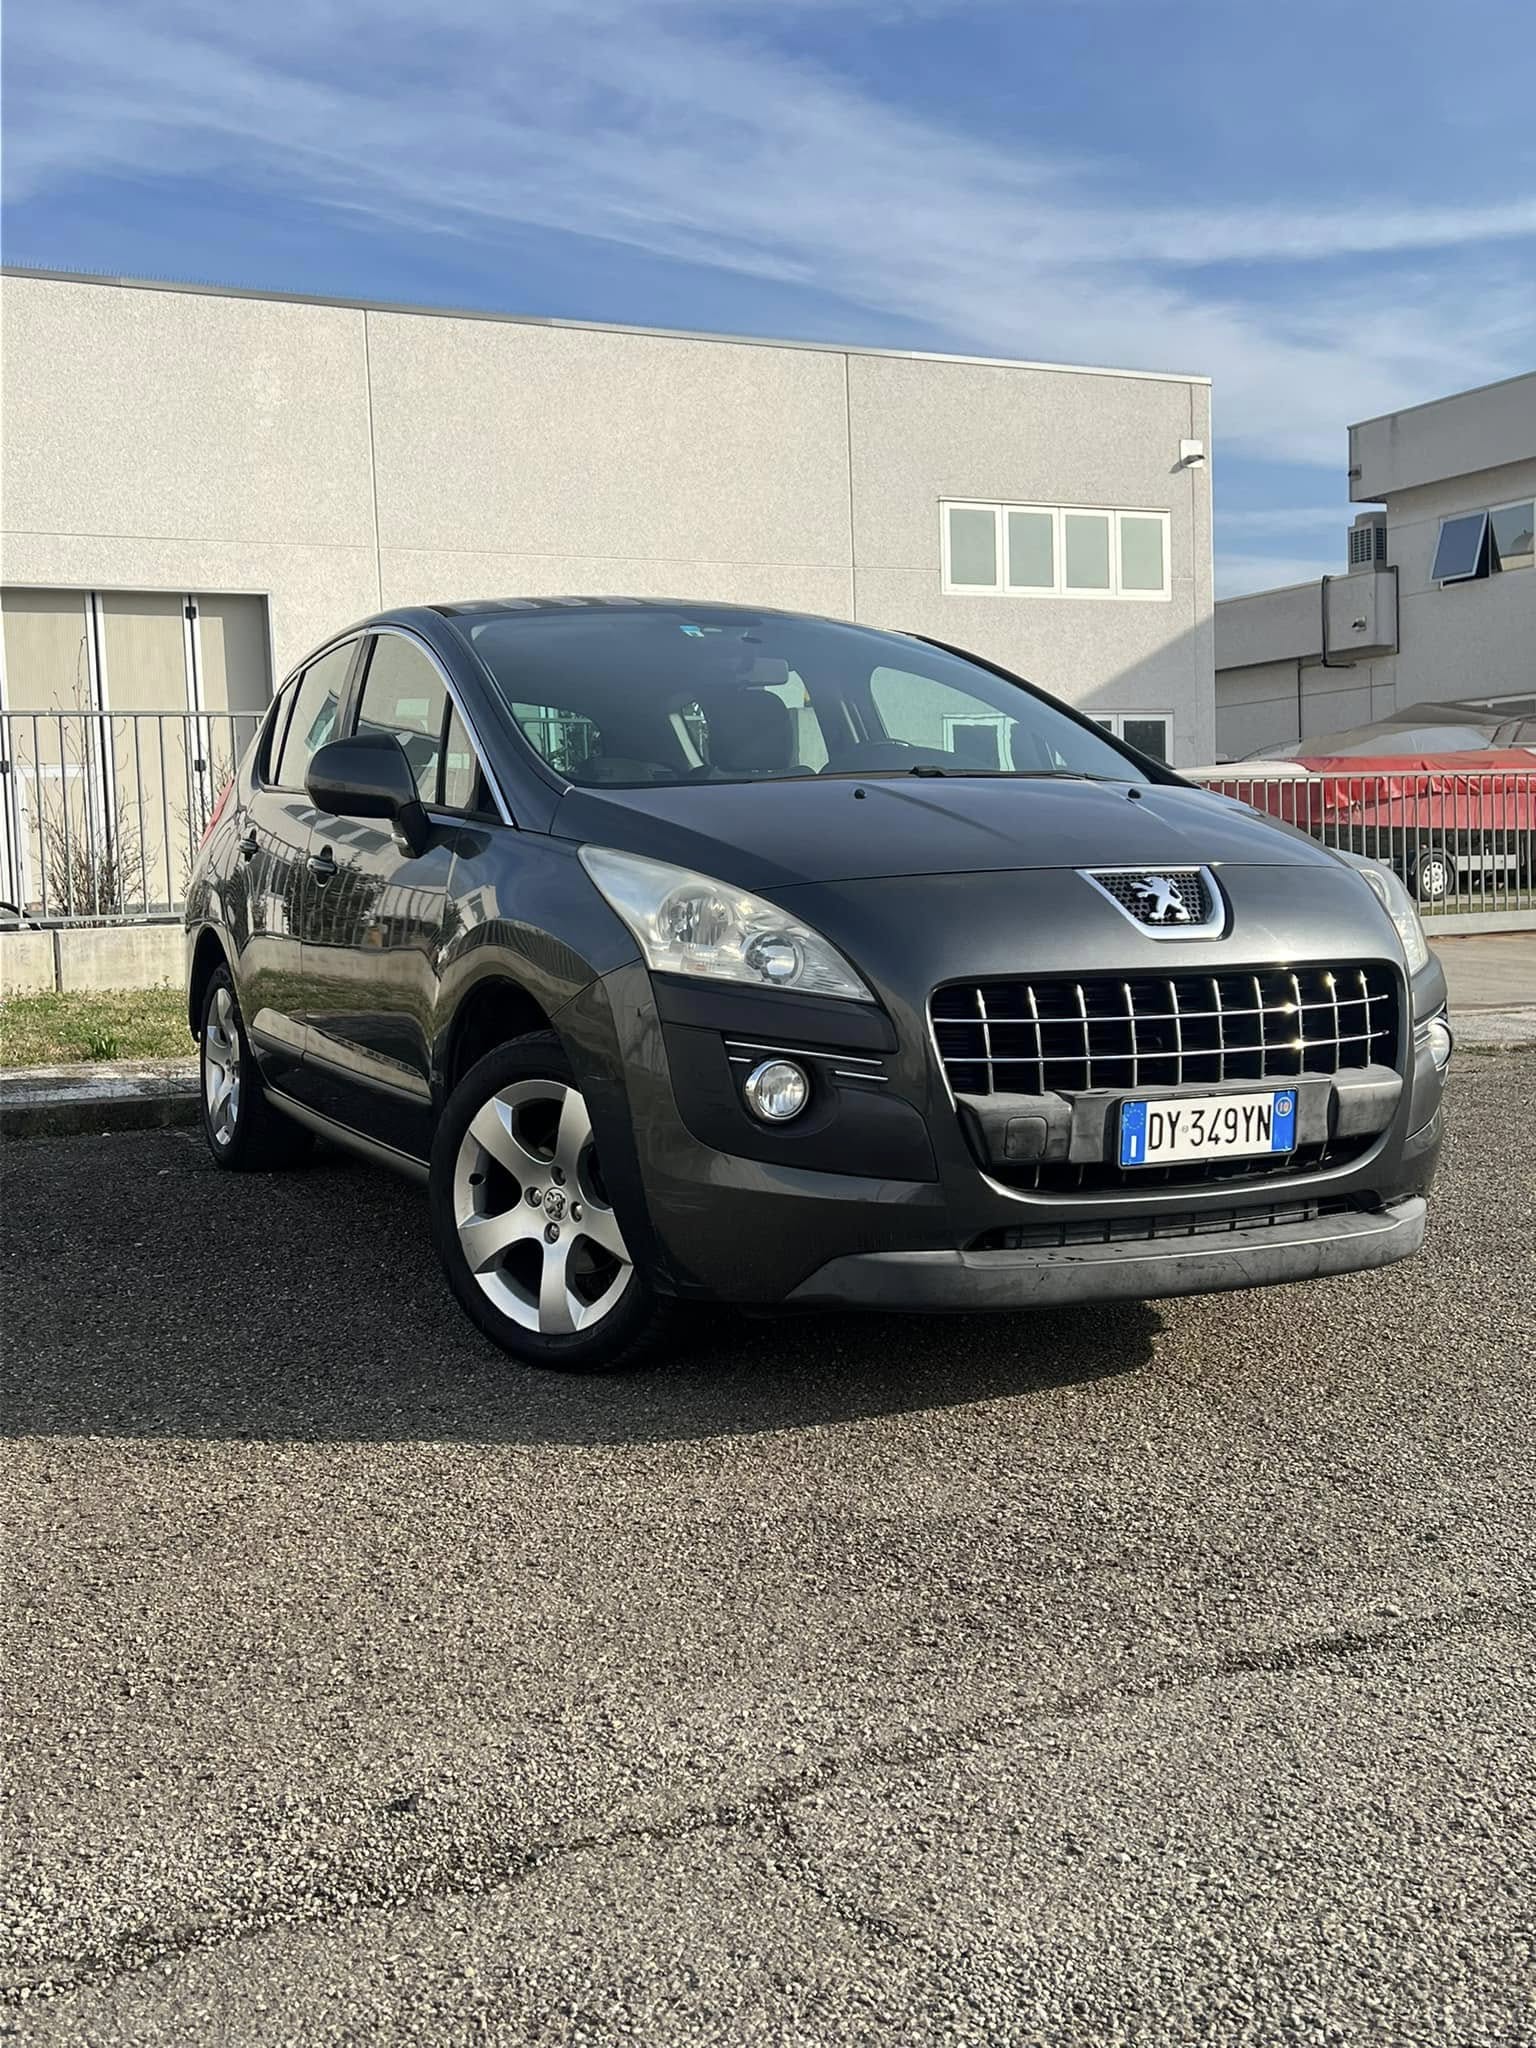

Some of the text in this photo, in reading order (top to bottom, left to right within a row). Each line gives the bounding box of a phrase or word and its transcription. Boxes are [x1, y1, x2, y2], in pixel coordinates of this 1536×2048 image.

[1148, 1104, 1272, 1150] DY 349YN
[1130, 1135, 1137, 1158] I
